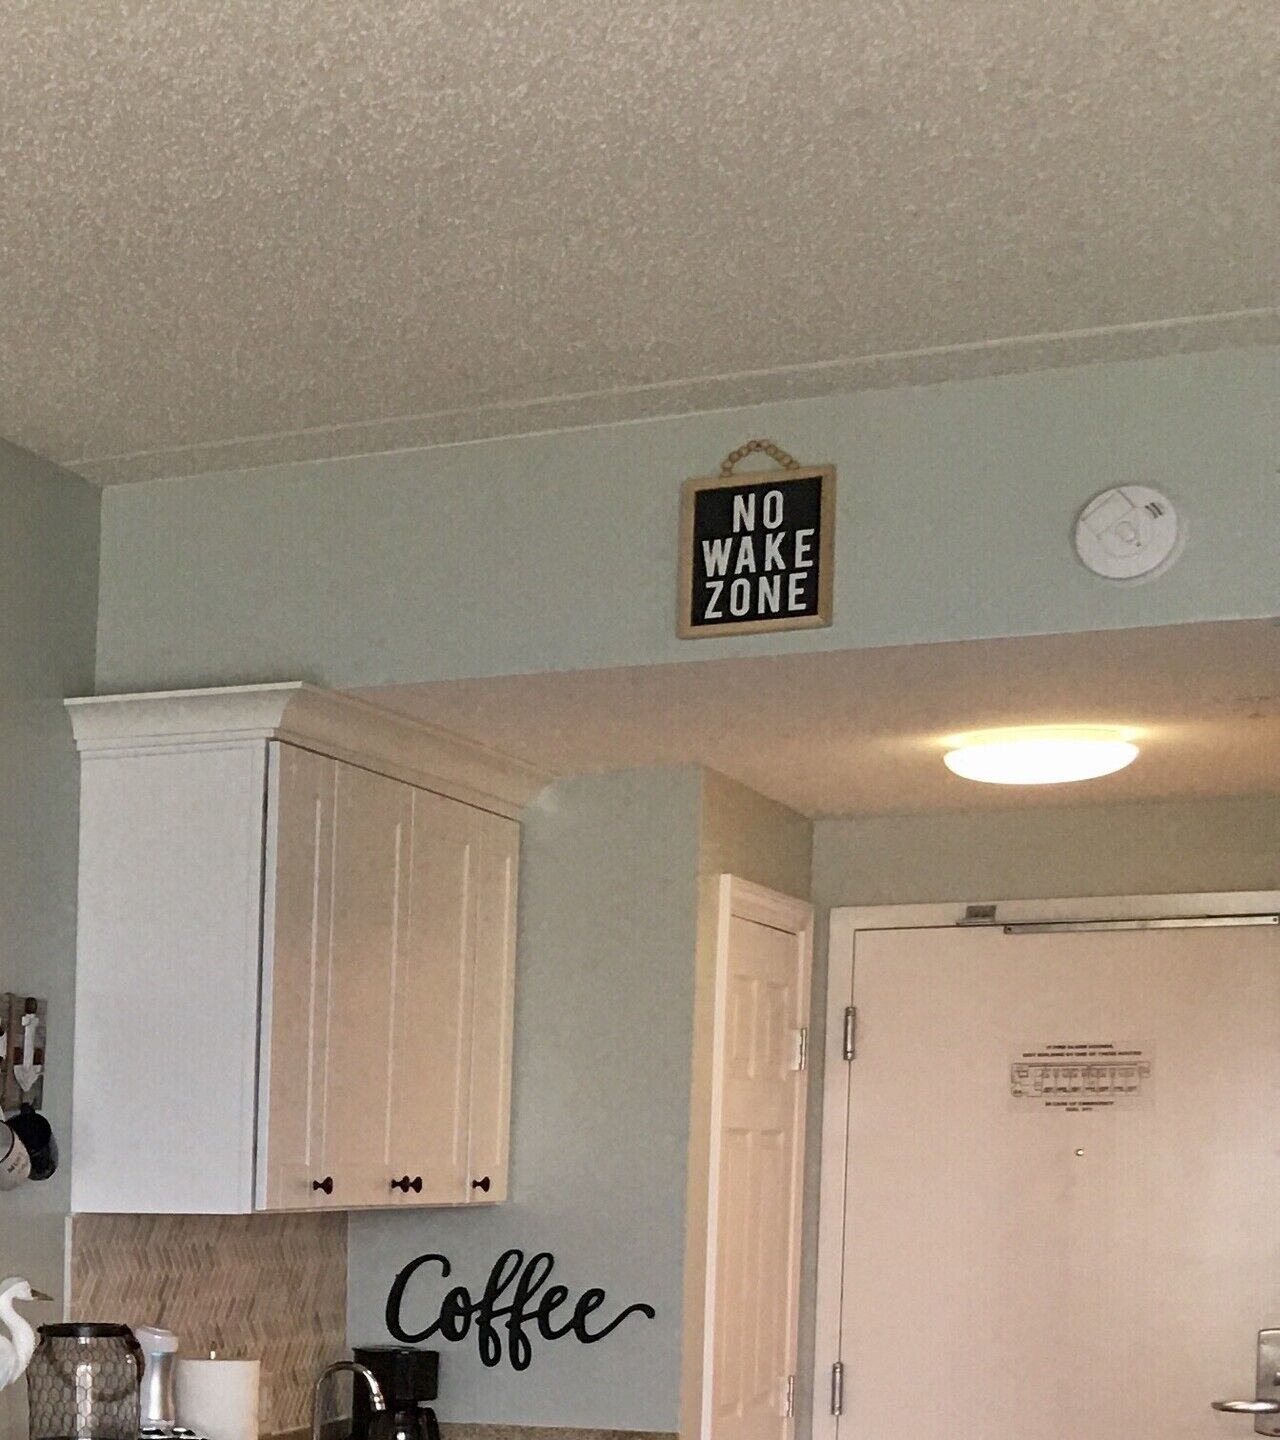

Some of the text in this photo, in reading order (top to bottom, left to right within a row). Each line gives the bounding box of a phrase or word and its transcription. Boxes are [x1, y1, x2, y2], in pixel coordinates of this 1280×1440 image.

[733, 490, 784, 533] NO
[702, 528, 815, 577] WAKE
[704, 572, 807, 619] ZONE
[385, 1249, 655, 1371] Coffee
